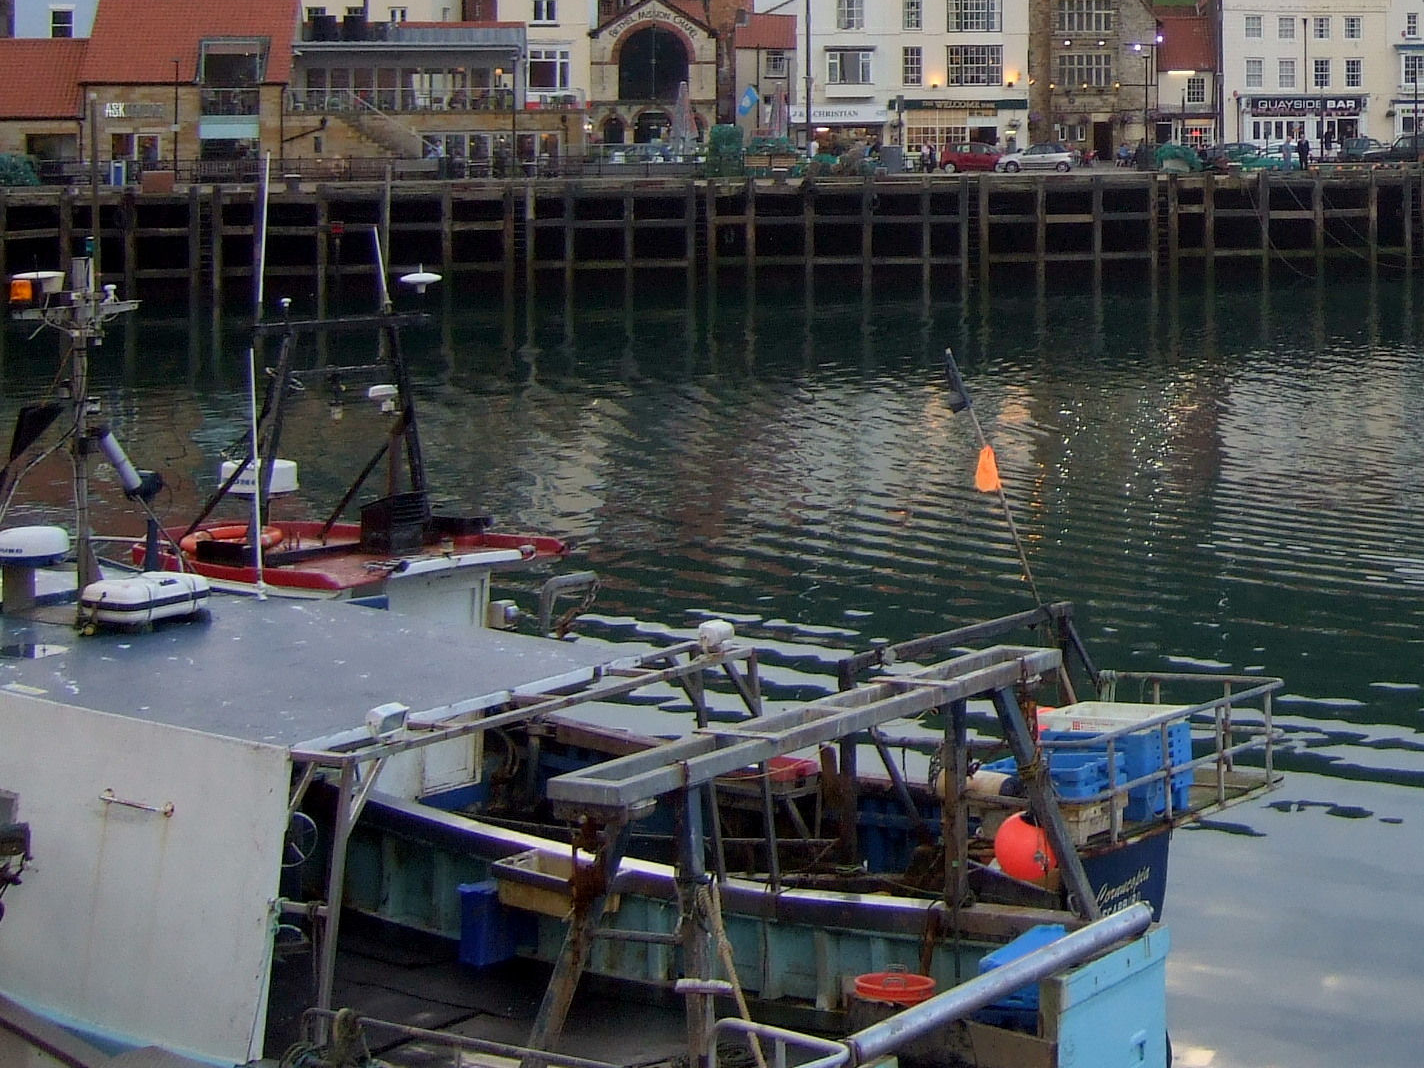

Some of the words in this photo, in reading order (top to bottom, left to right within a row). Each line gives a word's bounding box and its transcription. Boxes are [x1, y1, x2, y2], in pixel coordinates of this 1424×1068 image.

[638, 11, 671, 21] MISSION
[673, 15, 698, 39] CHAPEL
[935, 100, 980, 109] WELCOME
[1258, 99, 1321, 109] QUAYSIDE
[1326, 99, 1356, 108] BAR
[104, 102, 125, 118] ASK
[813, 110, 859, 118] CHRISTIAN
